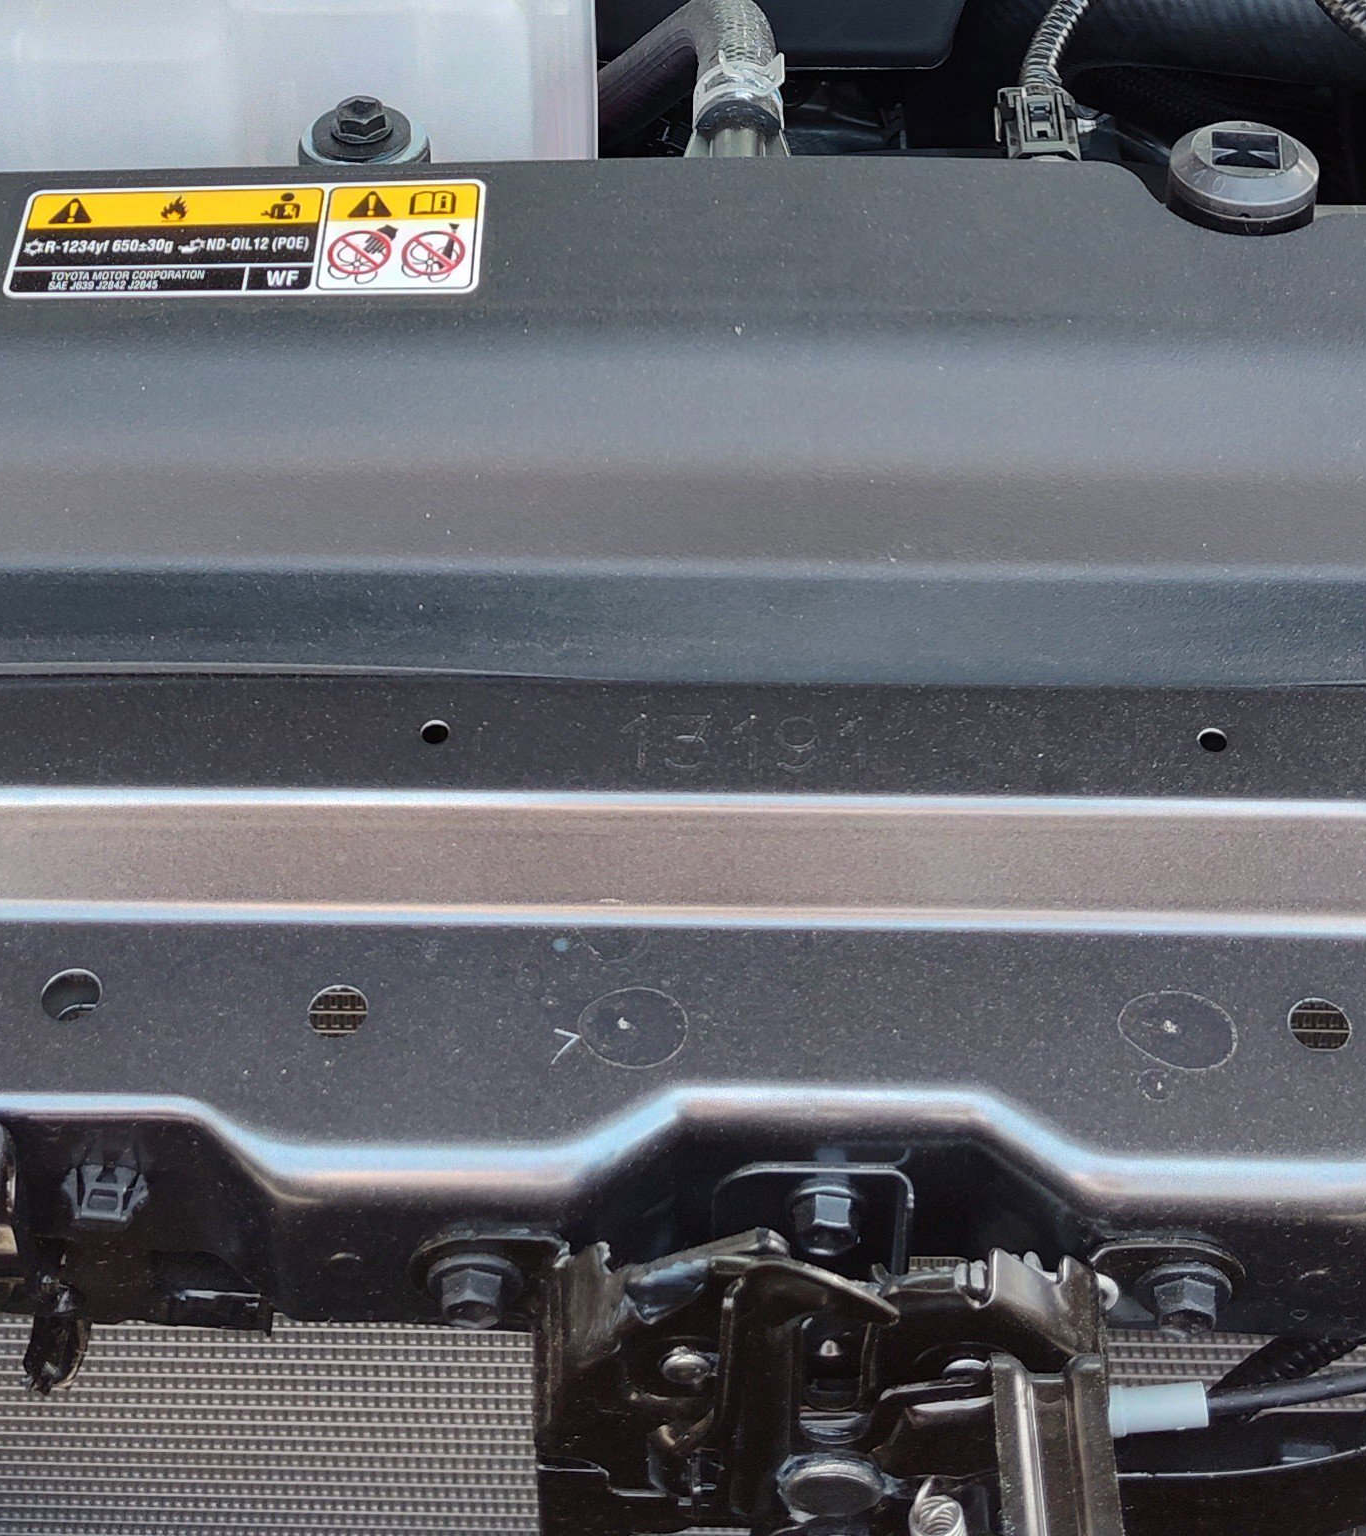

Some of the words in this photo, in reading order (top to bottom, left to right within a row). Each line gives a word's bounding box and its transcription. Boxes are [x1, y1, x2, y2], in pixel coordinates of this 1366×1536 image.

[43, 240, 110, 255] R-1234yf
[111, 239, 173, 254] 650±30g
[271, 236, 310, 253] (POE)
[50, 271, 90, 281] TOYOTA
[92, 271, 129, 280] MOTOR
[131, 269, 206, 280] CORPORATION
[266, 269, 300, 287] WF
[47, 282, 68, 291] SAE
